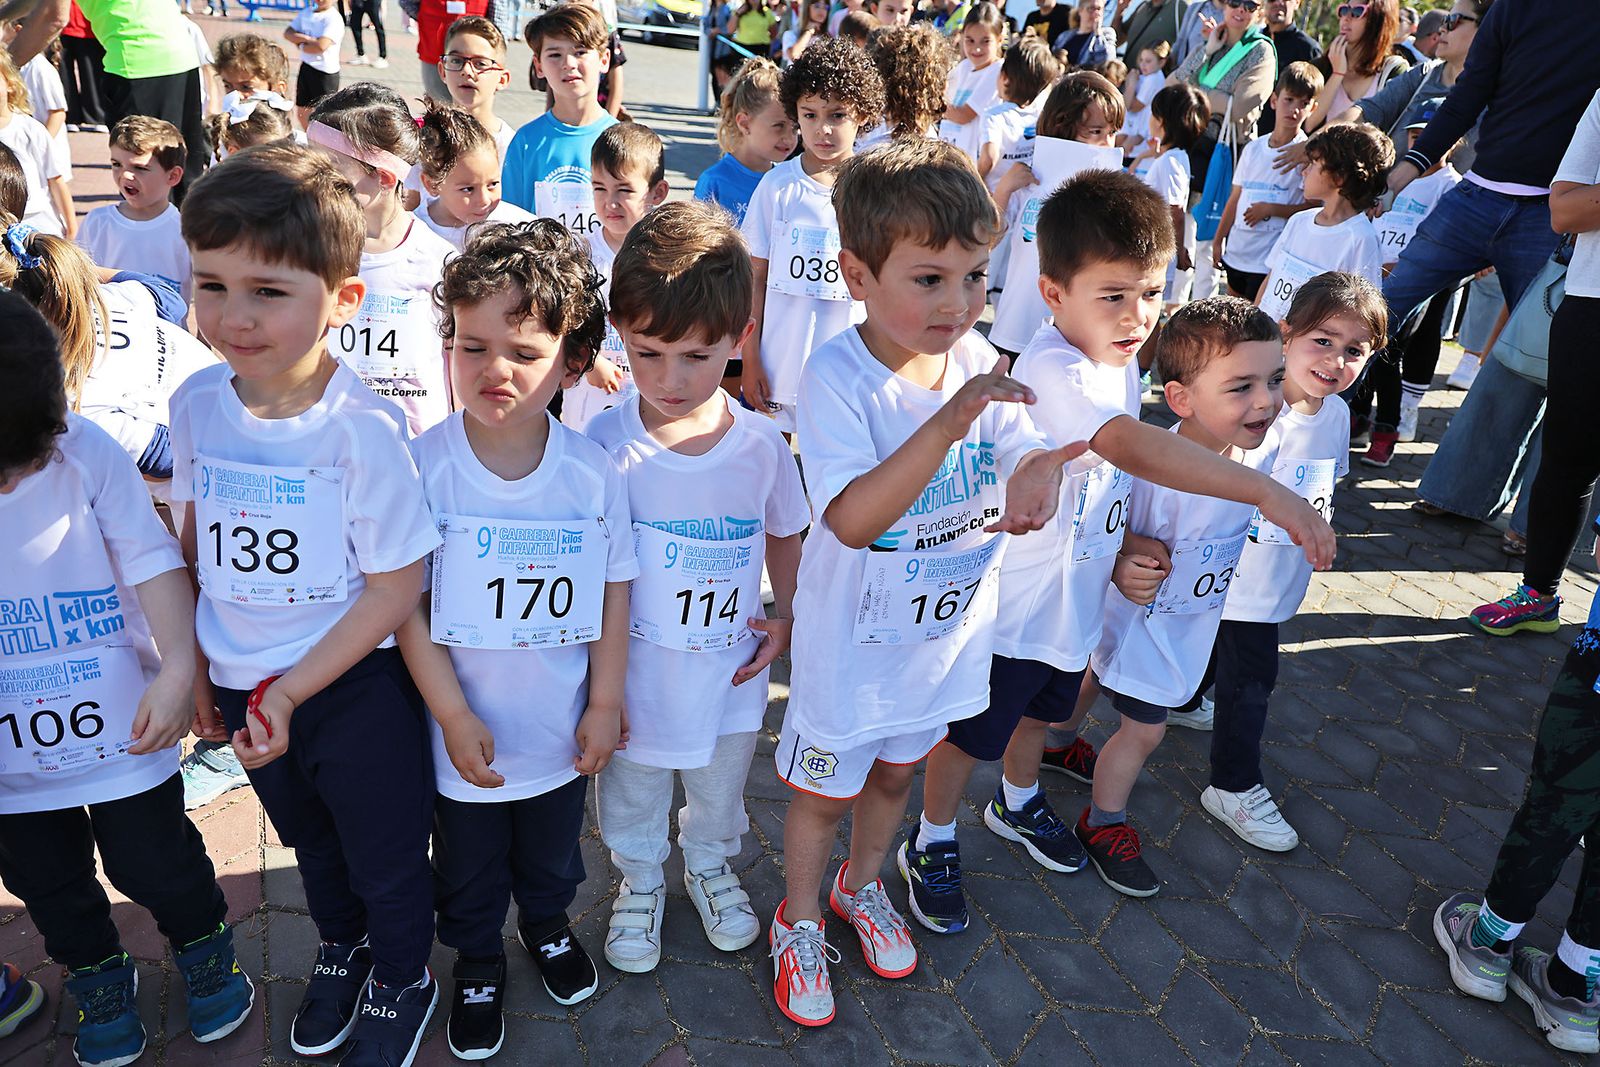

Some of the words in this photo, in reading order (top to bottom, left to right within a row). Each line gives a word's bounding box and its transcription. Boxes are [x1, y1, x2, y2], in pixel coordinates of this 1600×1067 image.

[559, 213, 602, 234] 146
[1381, 230, 1406, 247] 174
[790, 255, 839, 283] 038
[340, 323, 399, 358] 014
[202, 466, 213, 499] 9ª
[215, 468, 269, 488] CARRERA
[215, 483, 269, 503] INFANTIL
[276, 482, 305, 493] kilos
[276, 496, 283, 504] x
[286, 494, 305, 504] km
[917, 510, 971, 536] Fundación
[477, 526, 497, 558] 9ª
[499, 528, 556, 541] CARRERA
[562, 534, 583, 544] kilos
[914, 524, 968, 550] ATLANTIC
[208, 521, 300, 575] 138
[498, 541, 556, 555] INFANTIL
[569, 545, 582, 554] km
[665, 541, 683, 568] 9ª
[684, 545, 733, 558] CARRERA
[737, 549, 750, 560] kilos
[682, 557, 731, 571] INFANTIL
[905, 558, 925, 583] 9ª
[926, 551, 976, 567] CARRERA
[924, 562, 975, 578] INFANTIL
[487, 576, 574, 619] 170
[676, 586, 739, 627] 114
[911, 577, 982, 624] 167
[59, 595, 120, 624] kilos
[64, 627, 82, 646] x
[85, 613, 125, 640] km
[0, 663, 63, 681] ARRERA
[70, 661, 100, 674] kilos
[72, 675, 80, 683] x
[83, 671, 101, 680] km
[0, 701, 104, 749] 106
[313, 964, 348, 977] Polo
[361, 1003, 397, 1019] Polo
